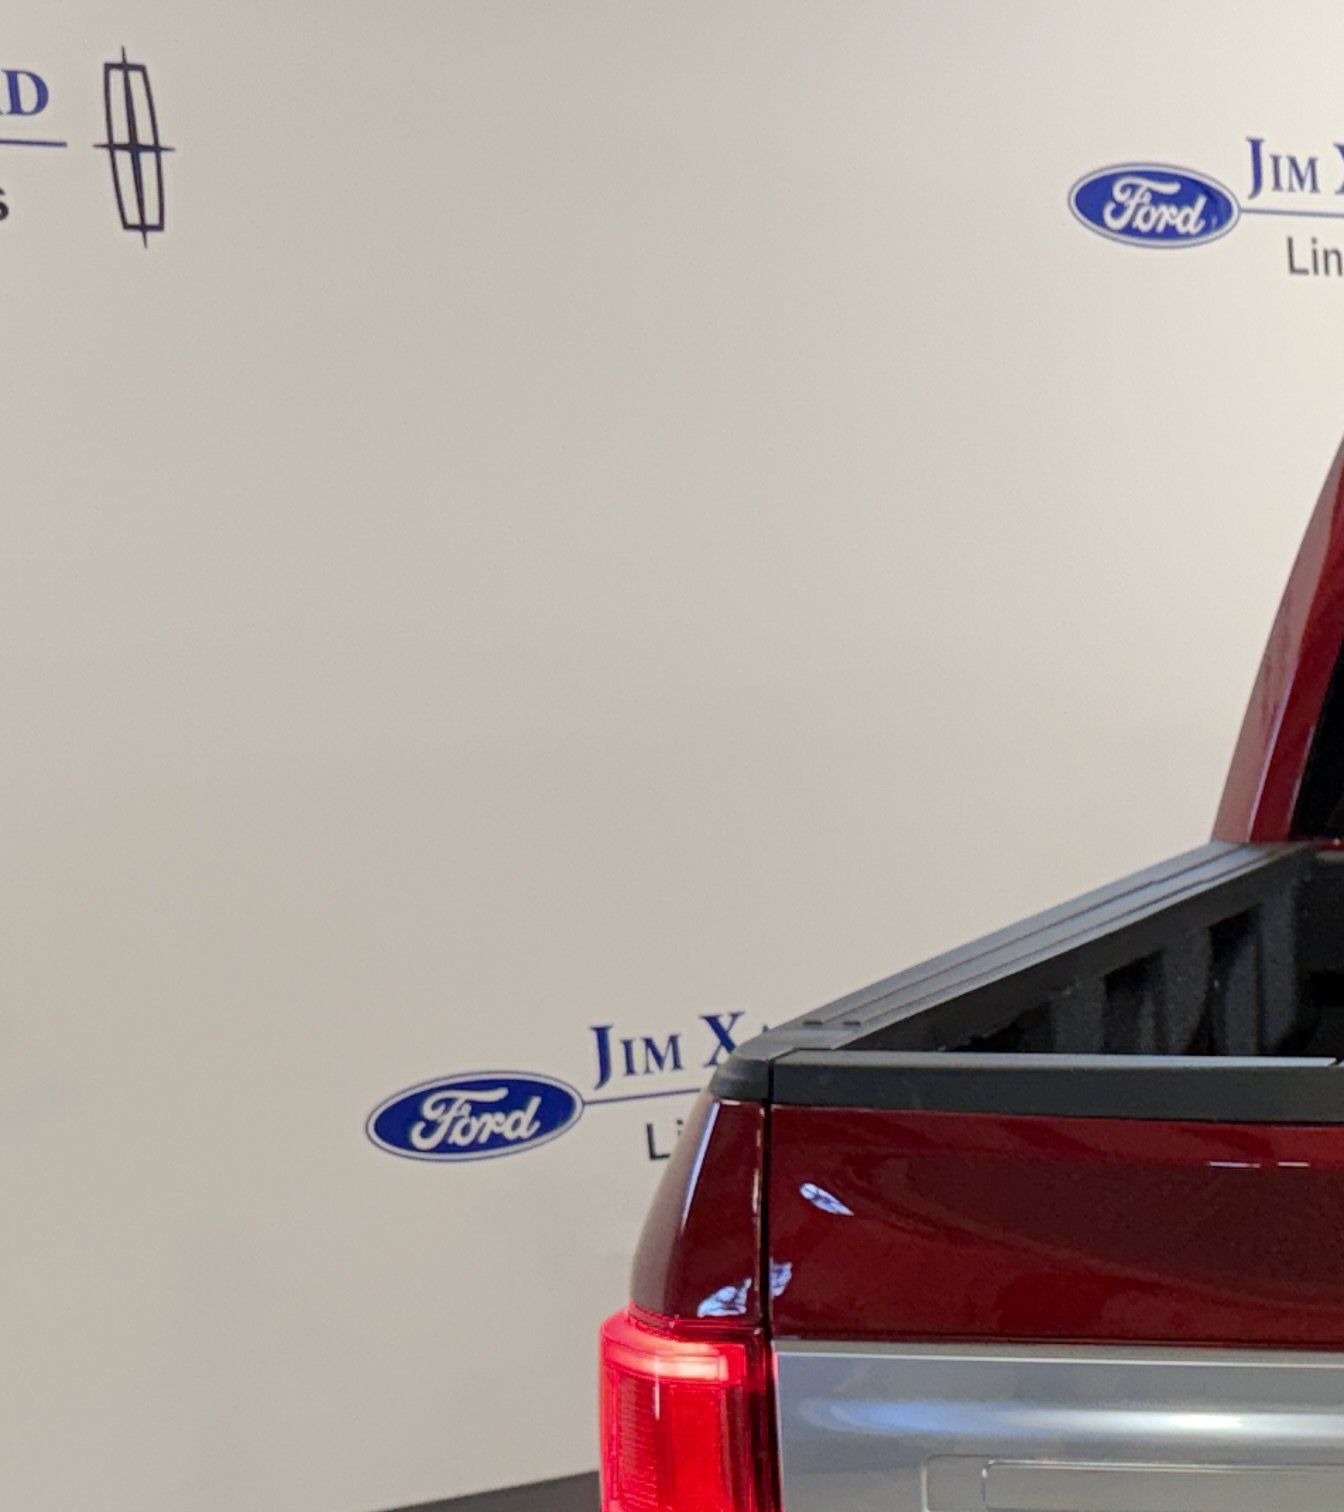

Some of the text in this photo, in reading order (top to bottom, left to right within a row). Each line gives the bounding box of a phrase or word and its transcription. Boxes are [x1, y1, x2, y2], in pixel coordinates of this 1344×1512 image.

[1244, 136, 1319, 199] JIM
[1103, 176, 1206, 235] Ford
[590, 1024, 684, 1091] JIM
[410, 1087, 543, 1151] Ford
